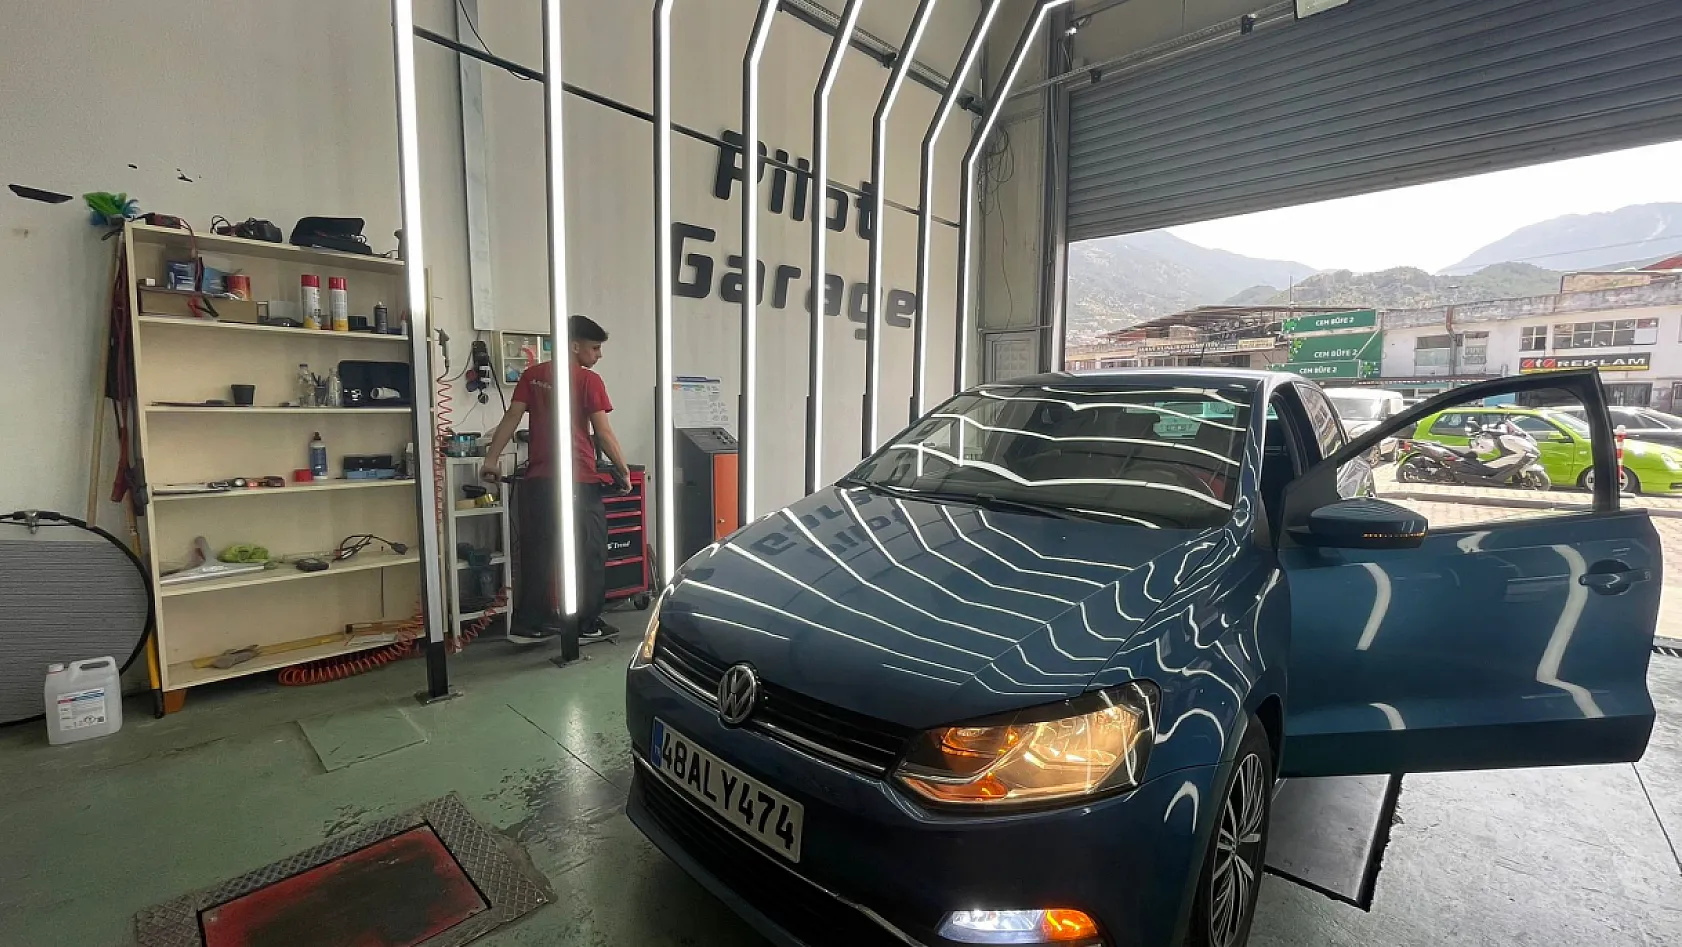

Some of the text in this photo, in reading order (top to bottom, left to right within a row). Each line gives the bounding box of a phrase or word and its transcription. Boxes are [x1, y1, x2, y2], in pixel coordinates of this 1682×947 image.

[714, 129, 873, 240] Pilot
[671, 221, 917, 340] Garage
[1557, 358, 1645, 367] REKLAM
[662, 732, 795, 851] 48ALY474
